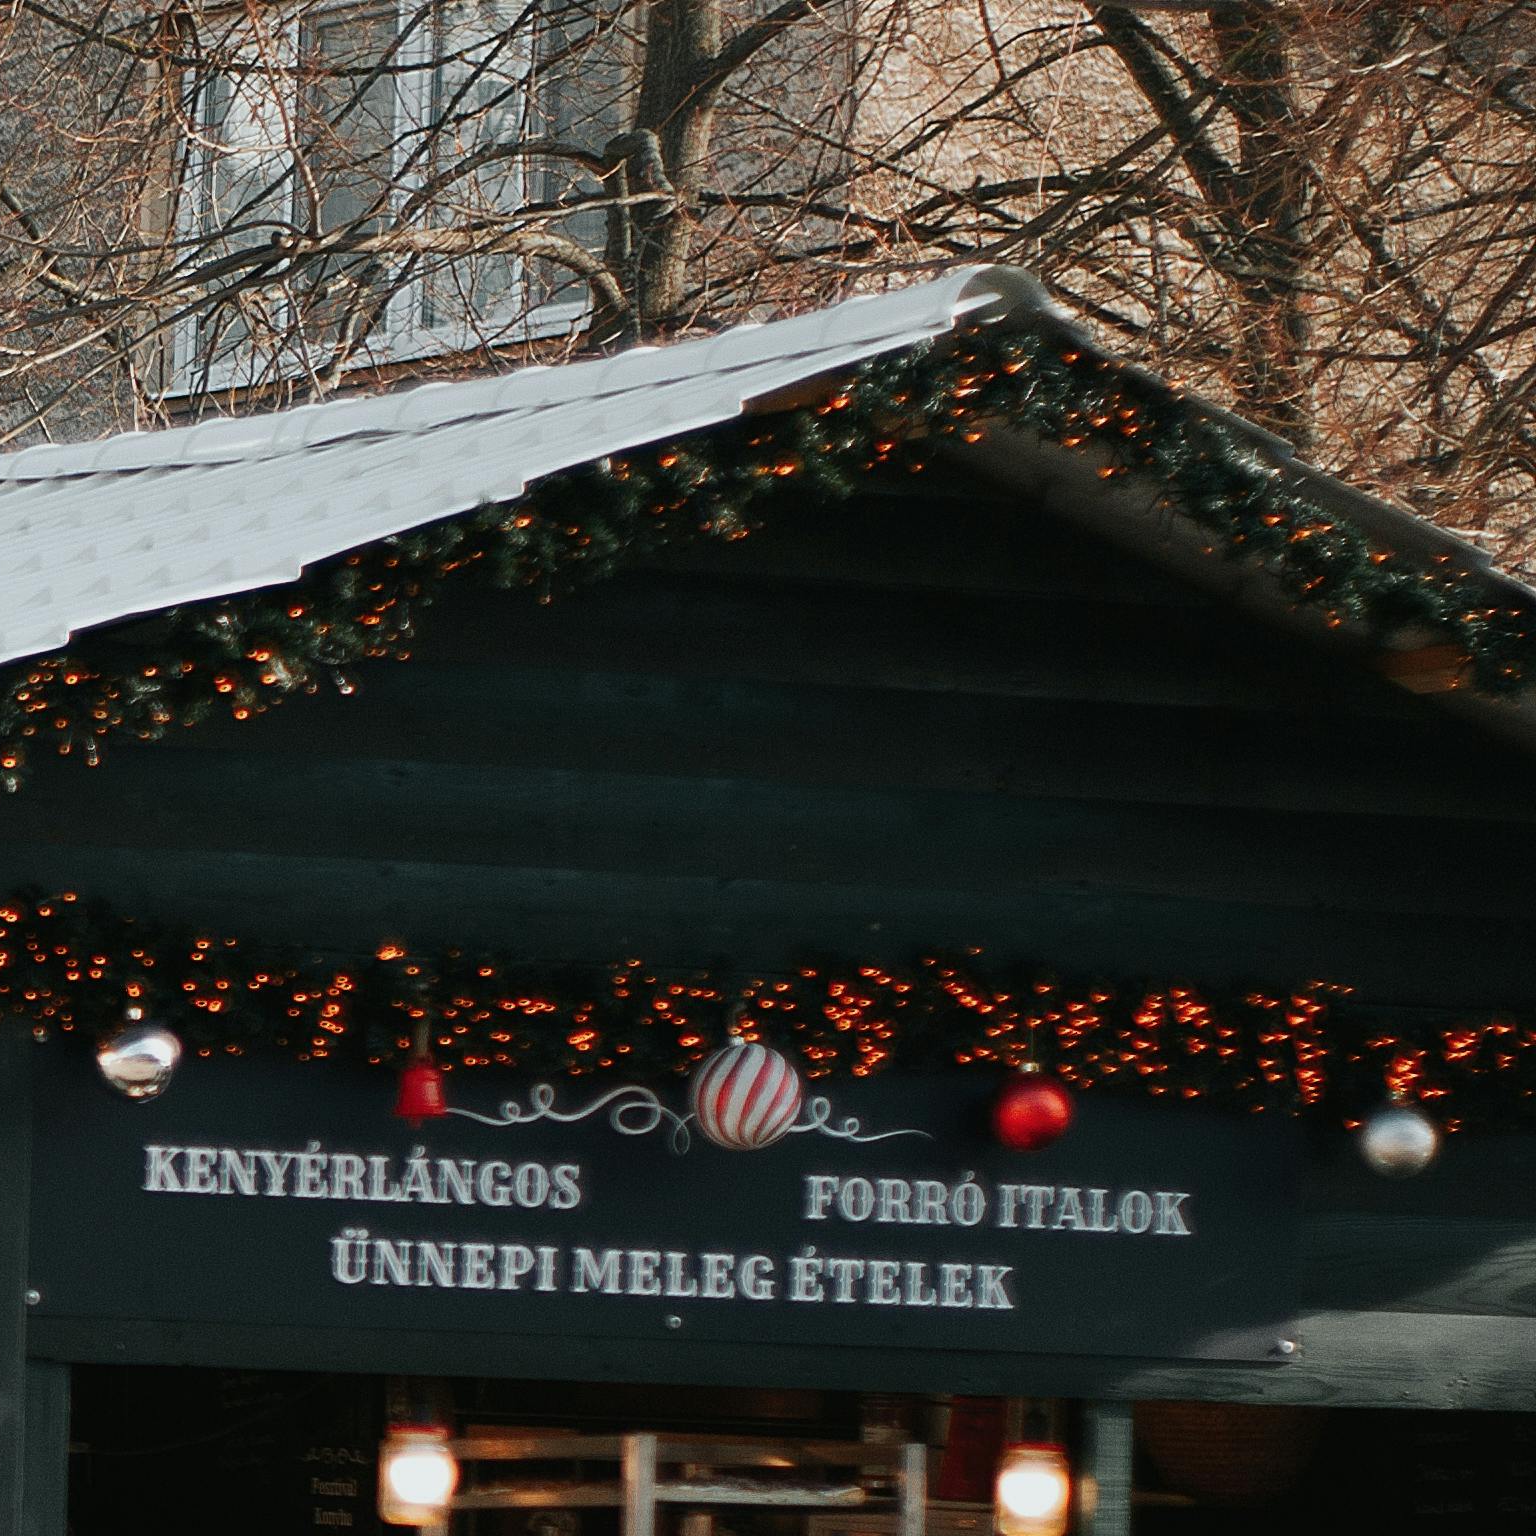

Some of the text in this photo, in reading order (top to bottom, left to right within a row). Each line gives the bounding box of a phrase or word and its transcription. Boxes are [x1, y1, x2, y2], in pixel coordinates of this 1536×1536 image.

[144, 1142, 583, 1211] KENYÉRLÁNGOS
[805, 1169, 1192, 1237] FORRÓ ITALOK
[331, 1228, 1016, 1310] ÜNNEPI MELEG ÉTELEK
